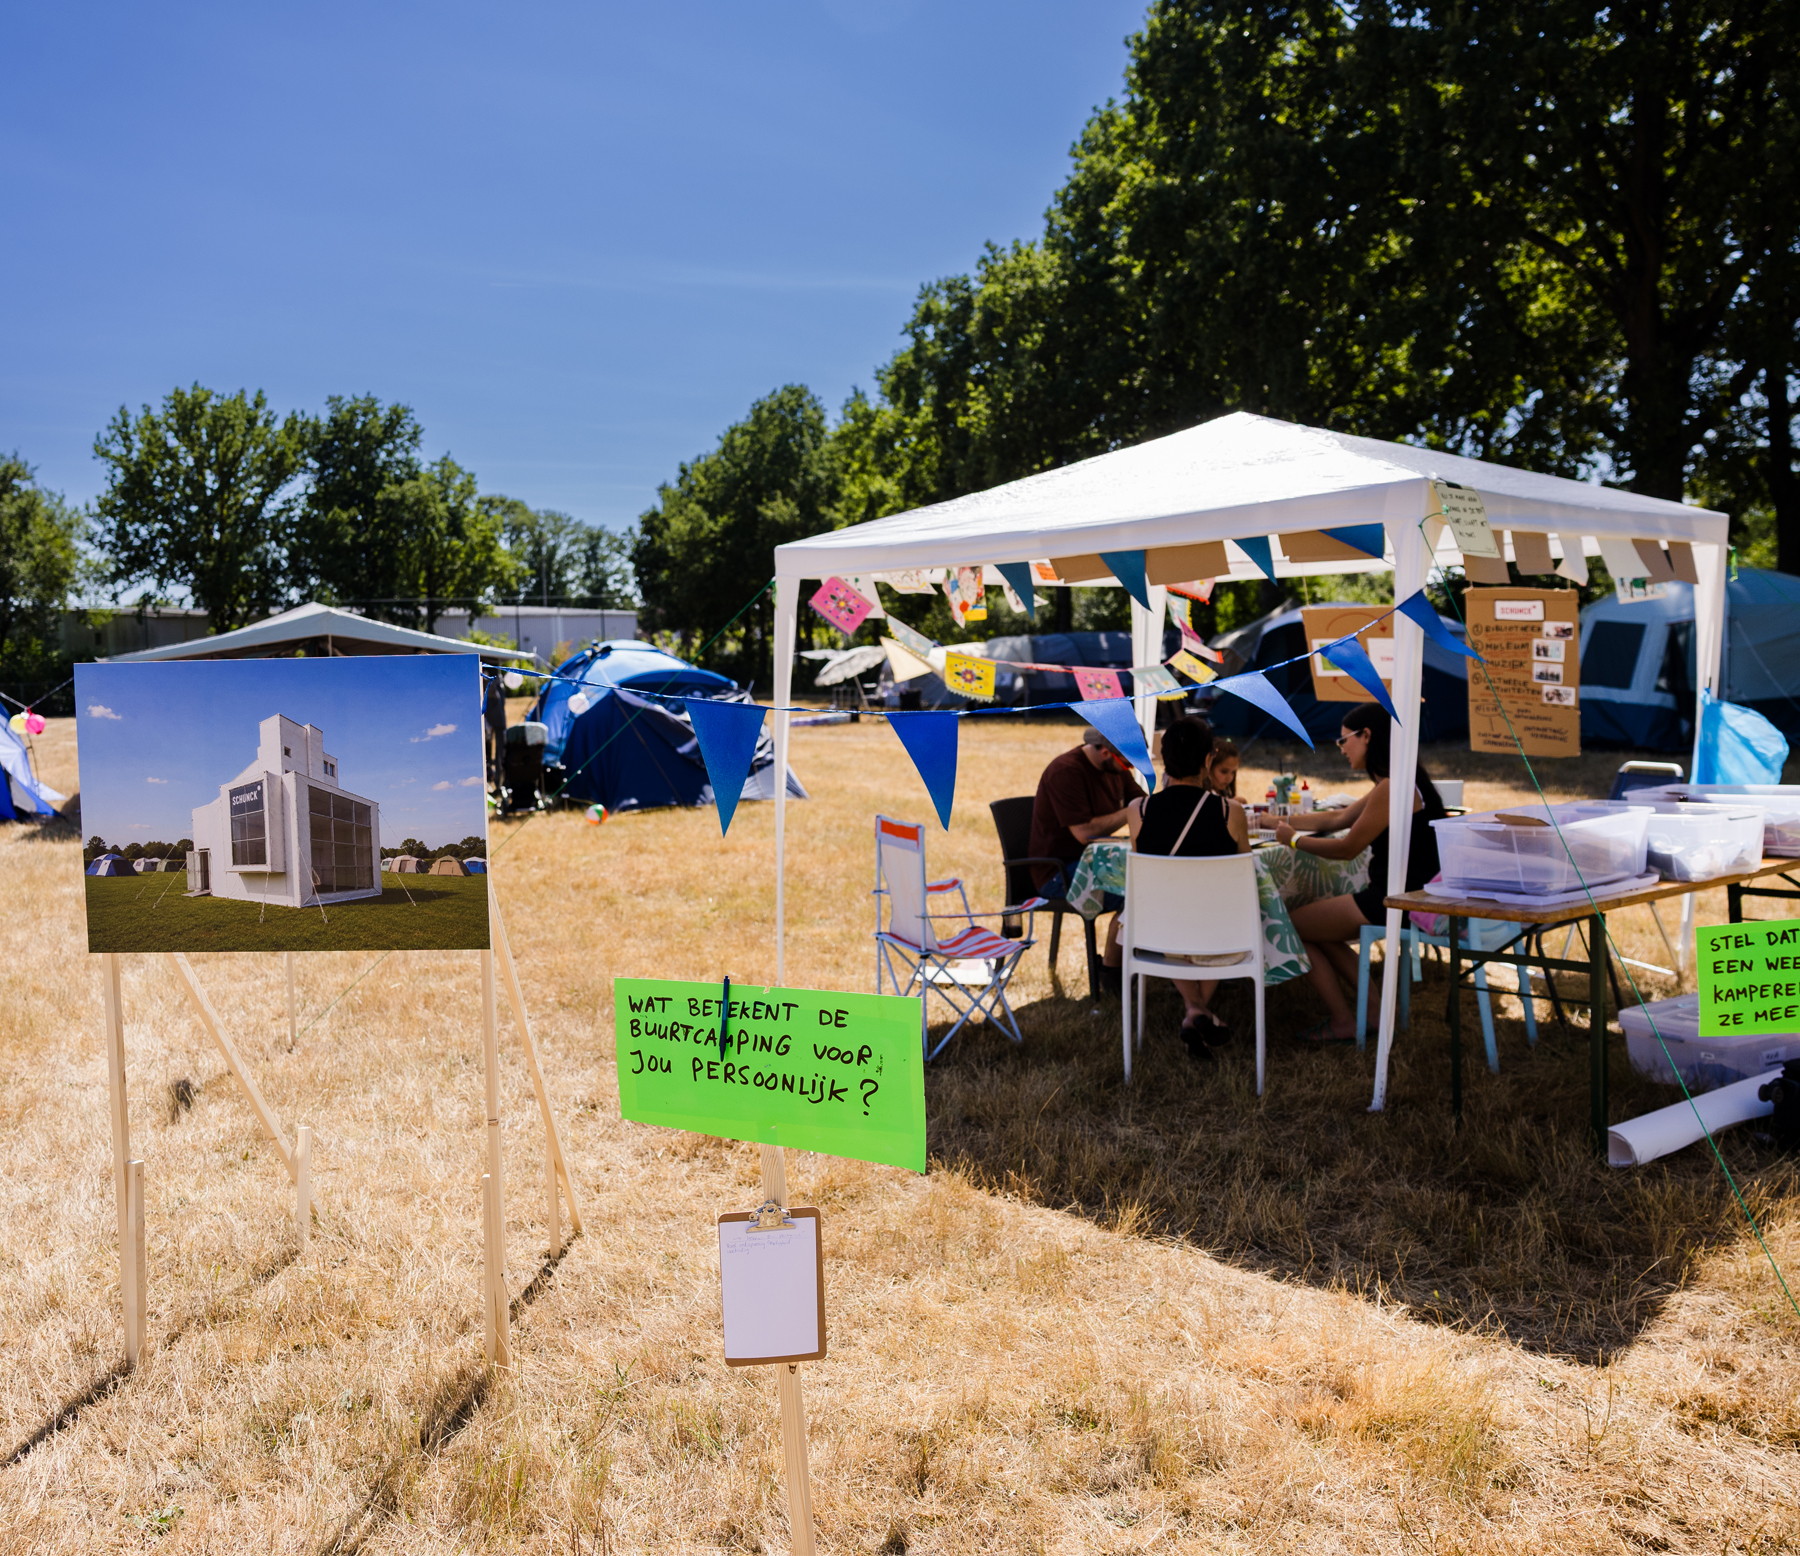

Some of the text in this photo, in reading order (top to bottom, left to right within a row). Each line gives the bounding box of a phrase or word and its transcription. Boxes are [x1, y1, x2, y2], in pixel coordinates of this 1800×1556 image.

[232, 790, 258, 805] SCHUNCK
[1710, 928, 1800, 952] STEL DAT
[1713, 960, 1753, 974] EEN
[1714, 982, 1800, 1004] KAMPERE
[628, 995, 850, 1028] WAT BETEKENT DE
[1718, 1005, 1800, 1026] ZE MEE
[629, 1050, 672, 1075] JOU
[813, 1043, 873, 1066] VOOR
